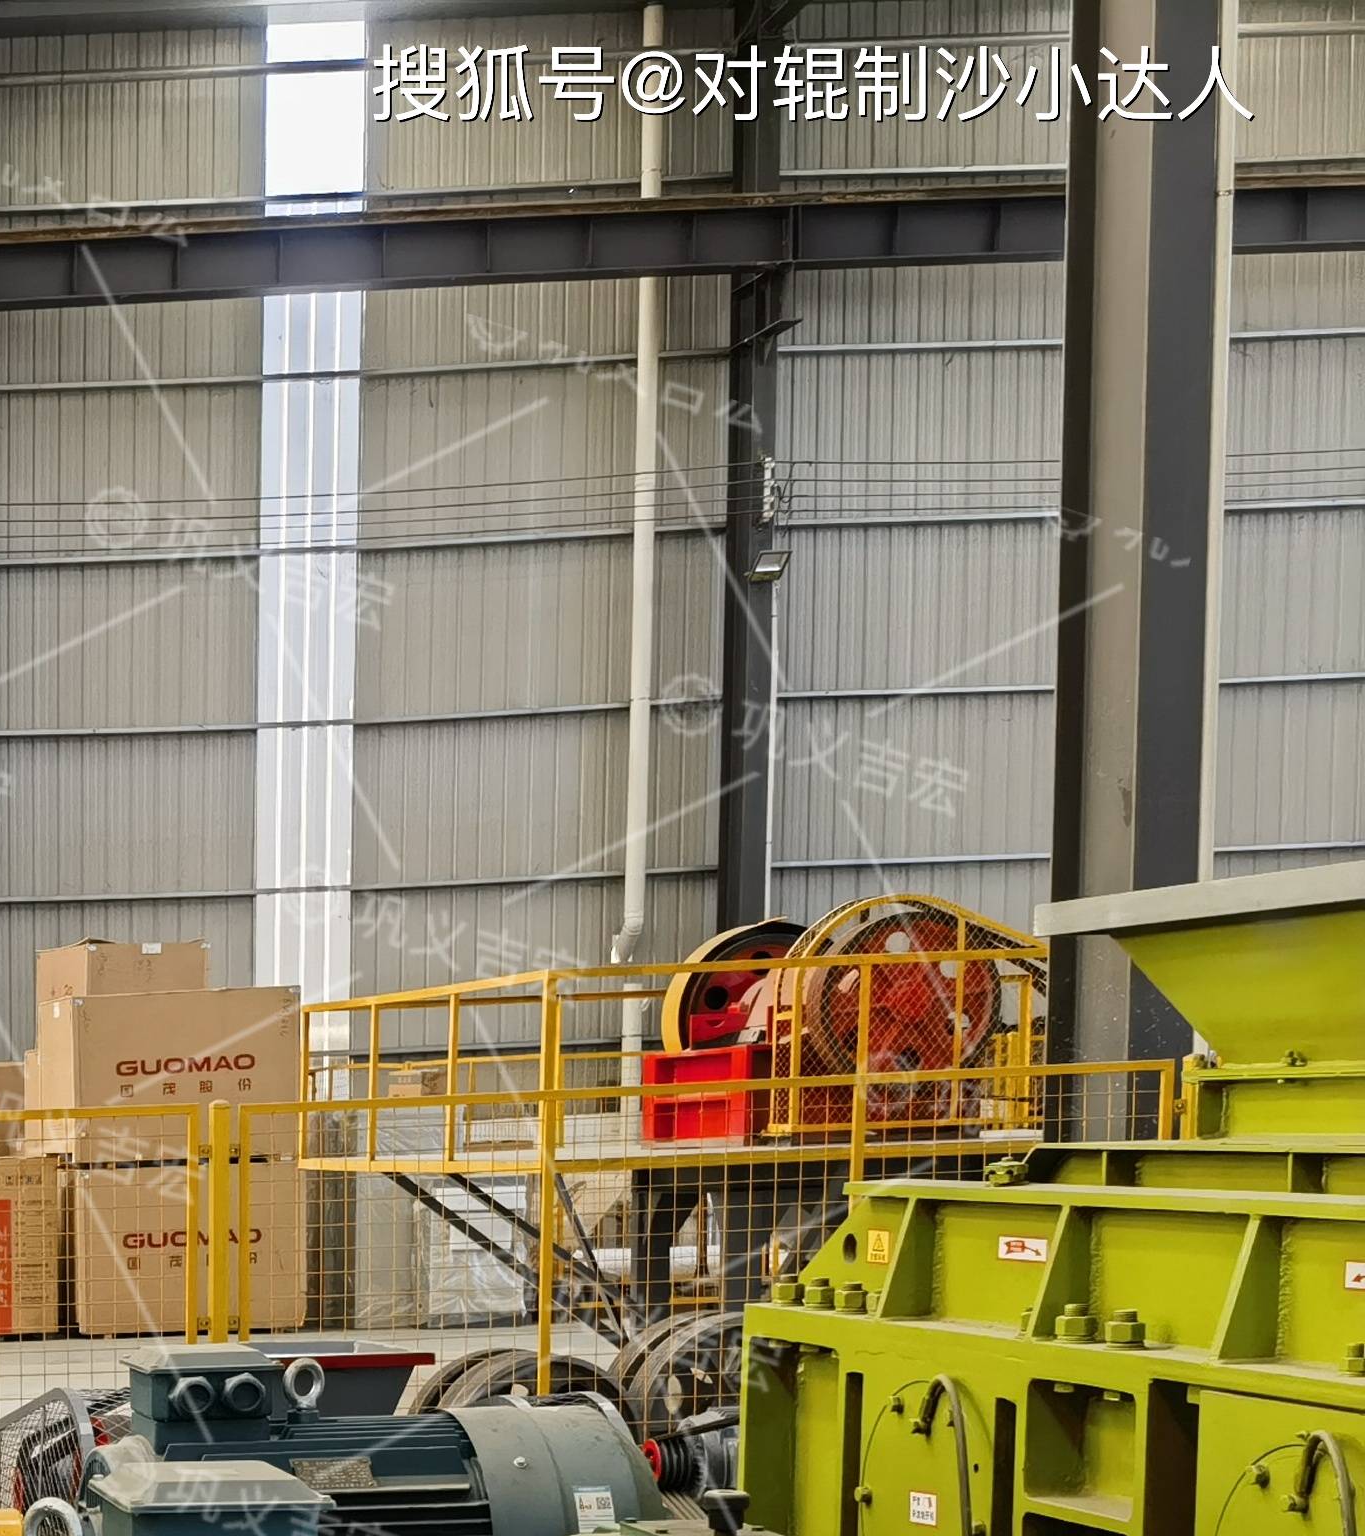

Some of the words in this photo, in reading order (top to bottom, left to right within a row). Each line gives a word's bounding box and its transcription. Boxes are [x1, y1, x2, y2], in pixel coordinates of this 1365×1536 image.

[115, 1053, 256, 1077] GUOMAO
[120, 1078, 252, 1098] 国茂股份
